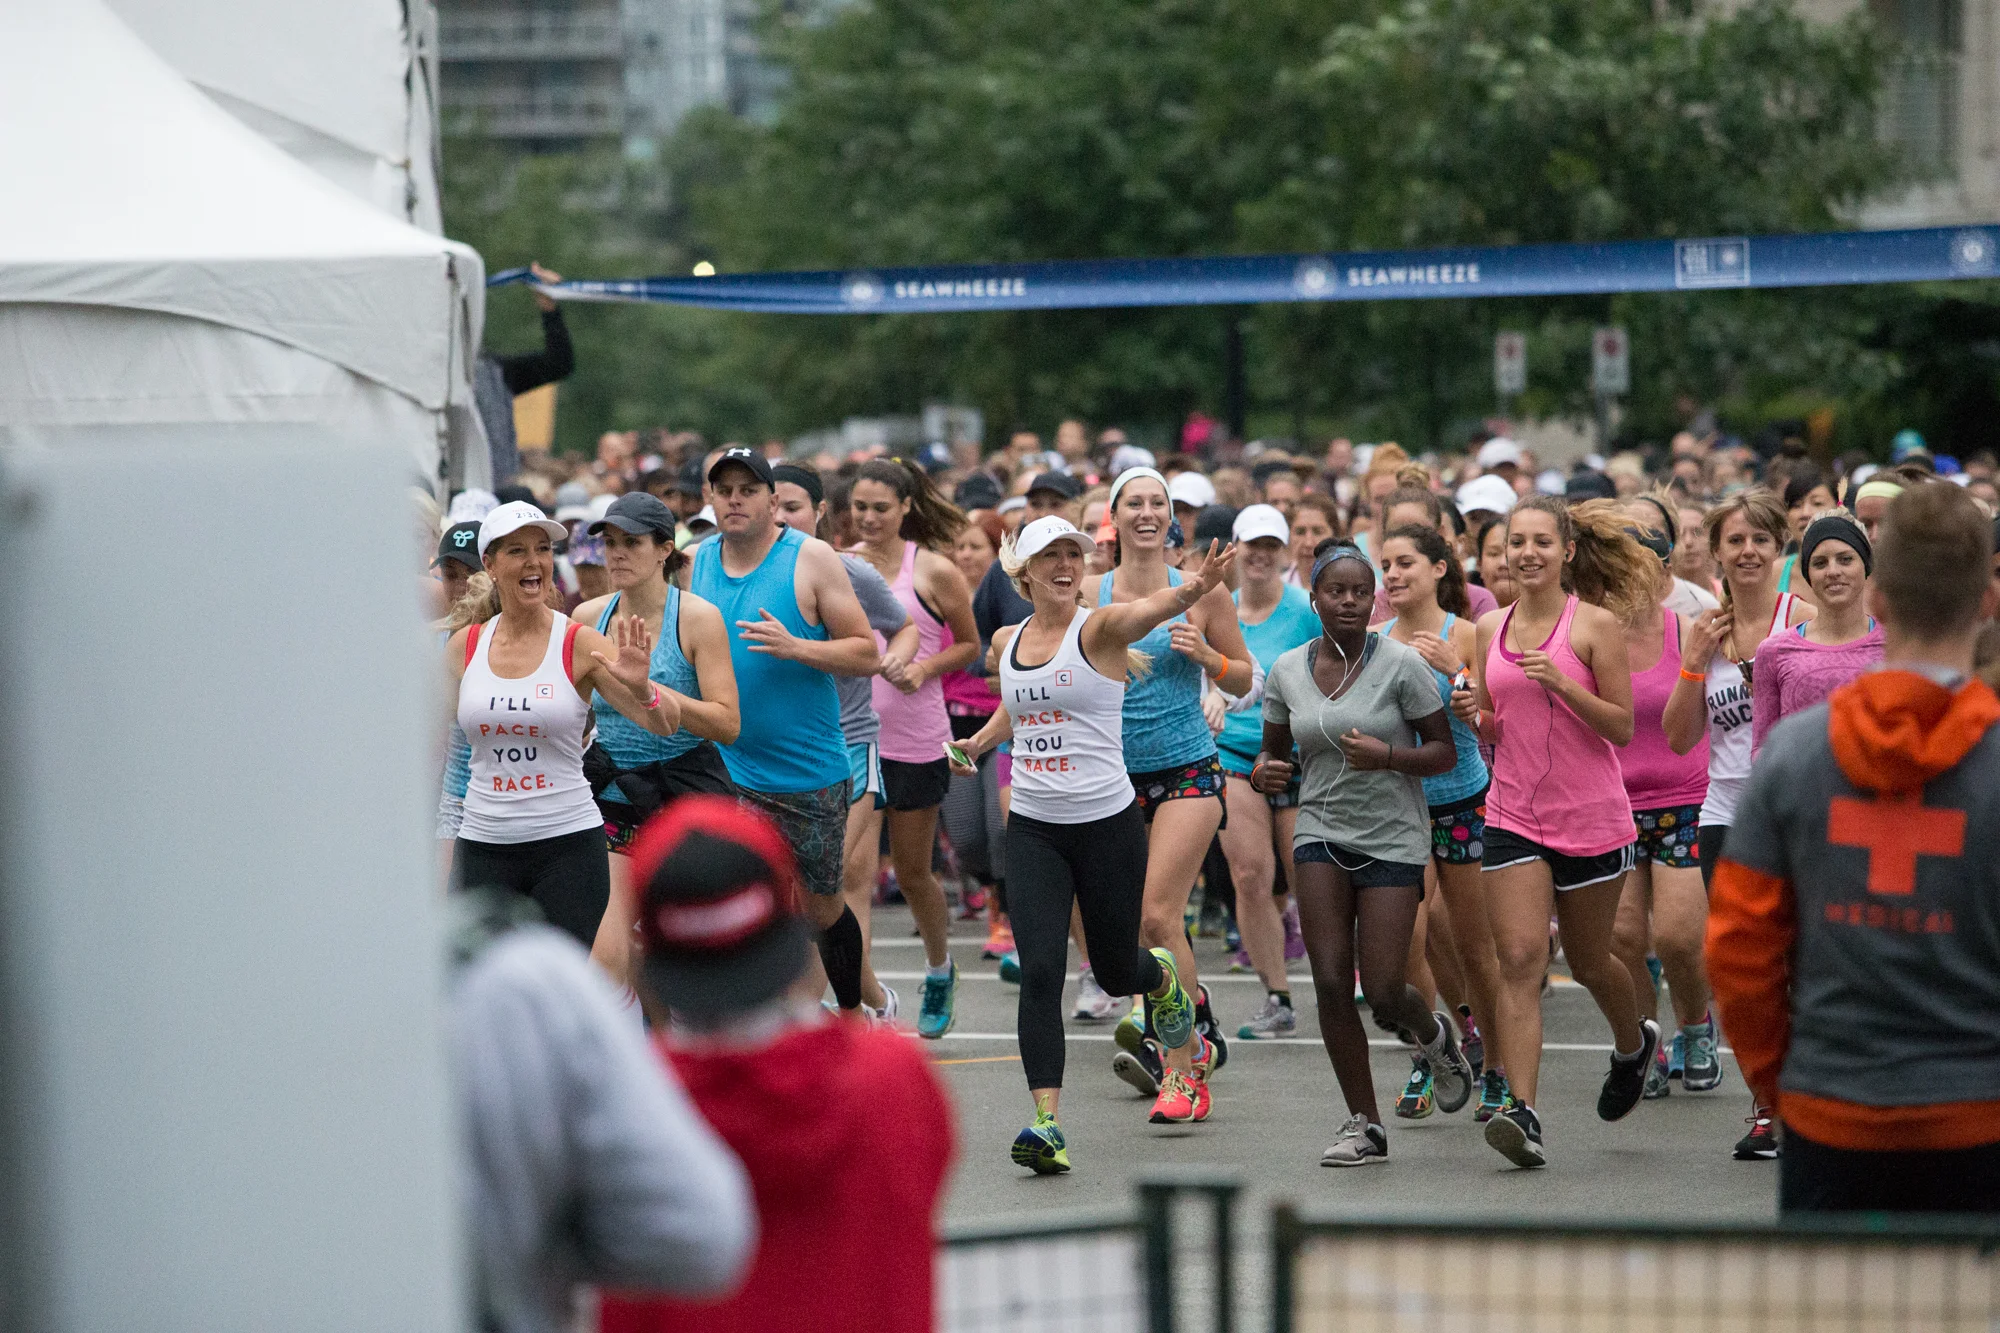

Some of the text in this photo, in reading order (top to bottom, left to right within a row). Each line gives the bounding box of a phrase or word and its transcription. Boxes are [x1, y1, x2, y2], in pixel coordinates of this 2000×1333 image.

[1348, 263, 1480, 287] SEAWHEEZE
[894, 279, 1026, 298] SEAWHEEZE
[1060, 674, 1067, 682] C
[541, 687, 548, 695] C
[1015, 686, 1050, 703] I'LL
[1707, 683, 1754, 712] RUNN
[489, 696, 531, 711] I'LL
[1017, 710, 1072, 727] PACE.
[1712, 703, 1753, 732] SUC
[479, 723, 548, 739] PACE.
[1025, 735, 1062, 753] YOU
[492, 746, 537, 763] YOU
[1023, 757, 1077, 772] RACE.
[492, 773, 554, 792] RACE.
